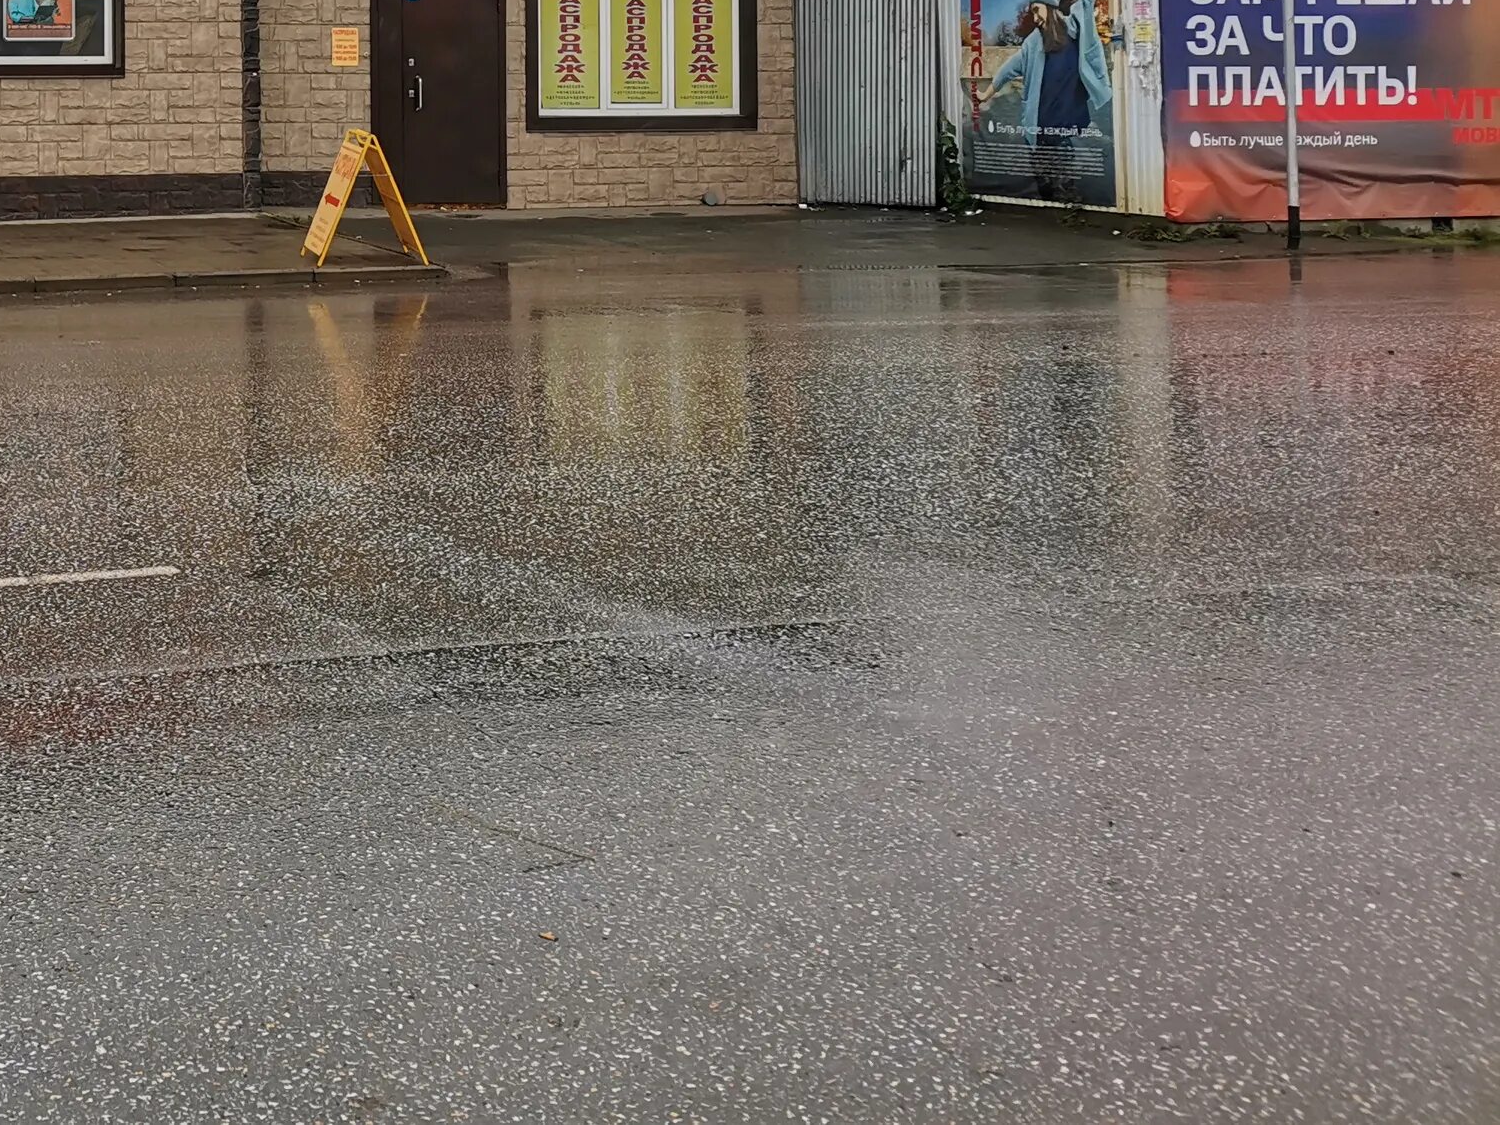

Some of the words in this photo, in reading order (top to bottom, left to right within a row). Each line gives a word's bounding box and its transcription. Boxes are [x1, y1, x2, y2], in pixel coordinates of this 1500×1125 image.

[1185, 15, 1250, 55] ЗА
[1262, 15, 1357, 56] ЧТО
[1188, 65, 1418, 106] ПЛАТИТЬ!
[1016, 125, 1043, 137] луе
[1203, 133, 1237, 147] Быть
[1240, 134, 1284, 150] лучше
[1296, 131, 1342, 148] аждый
[1345, 134, 1378, 148] день
